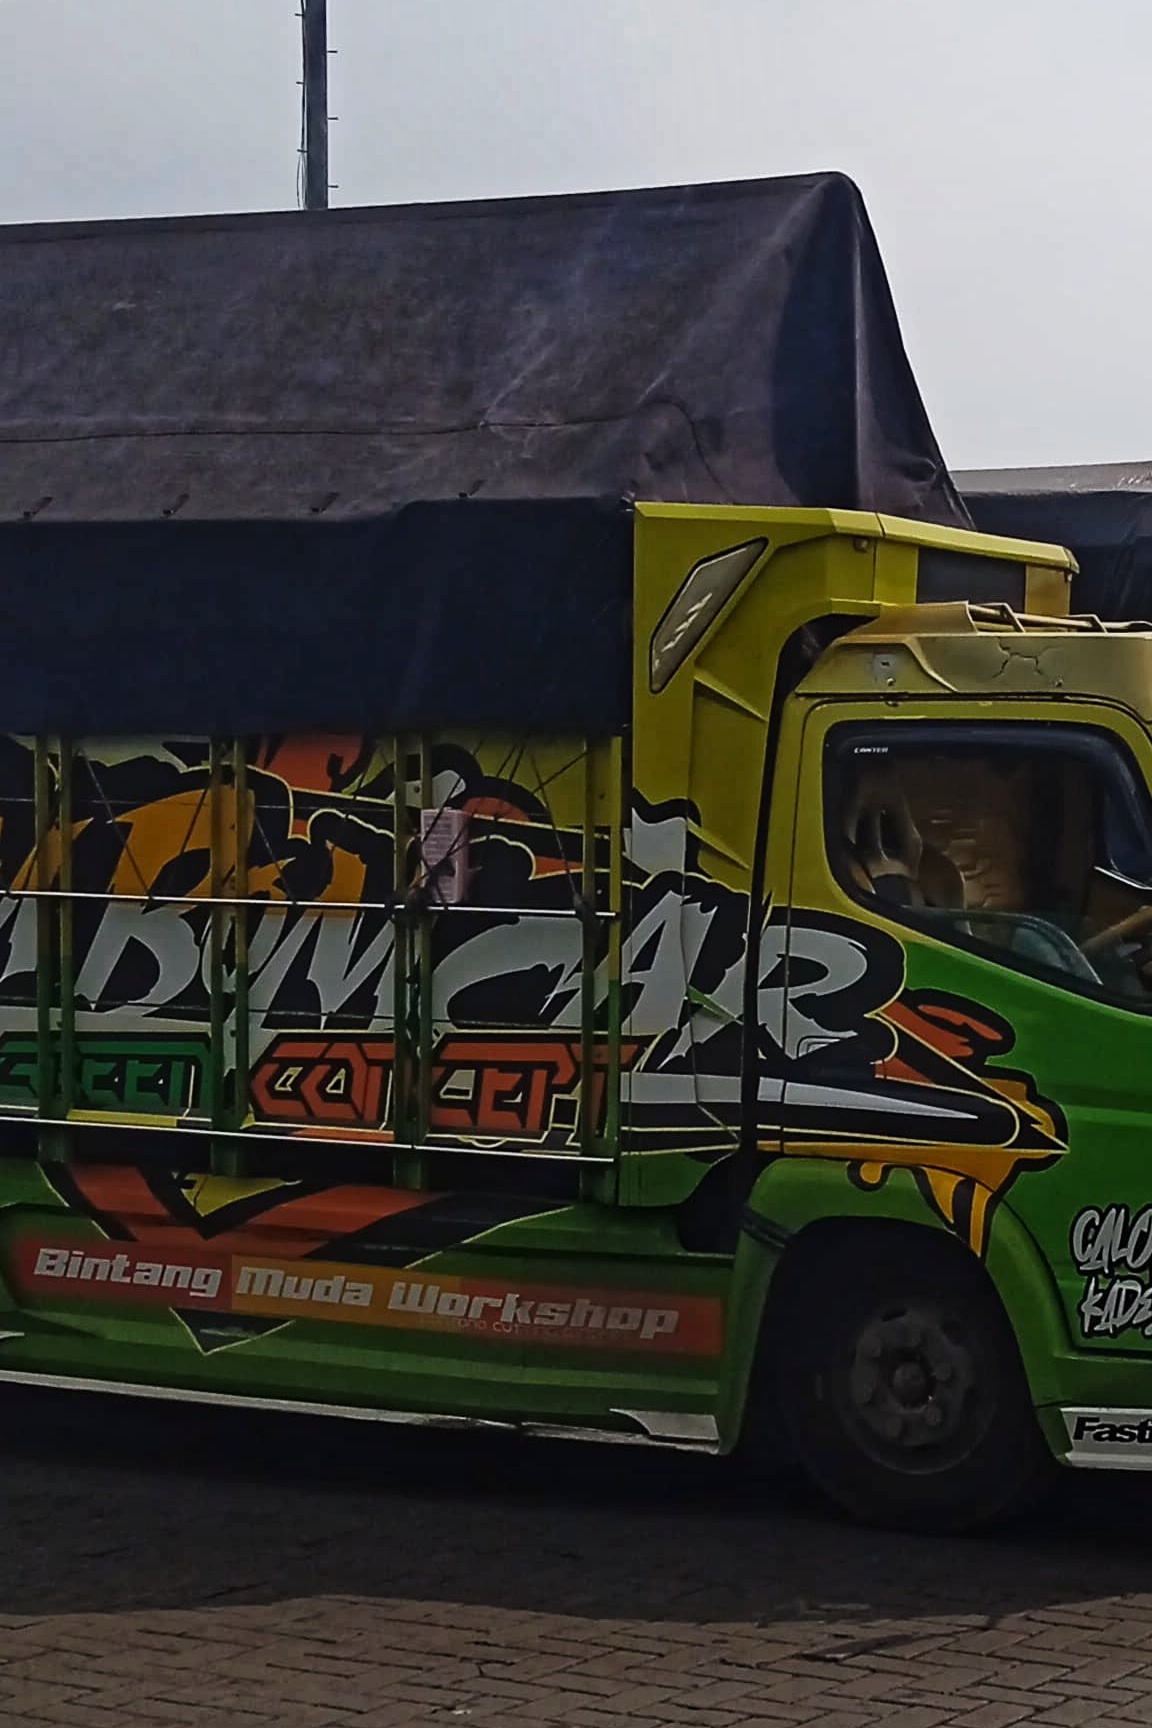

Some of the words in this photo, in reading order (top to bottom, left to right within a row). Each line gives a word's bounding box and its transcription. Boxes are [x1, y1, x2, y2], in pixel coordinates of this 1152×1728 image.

[34, 1247, 223, 1298] Bintang
[235, 1266, 374, 1307] Muda
[388, 1281, 679, 1339] Workshop
